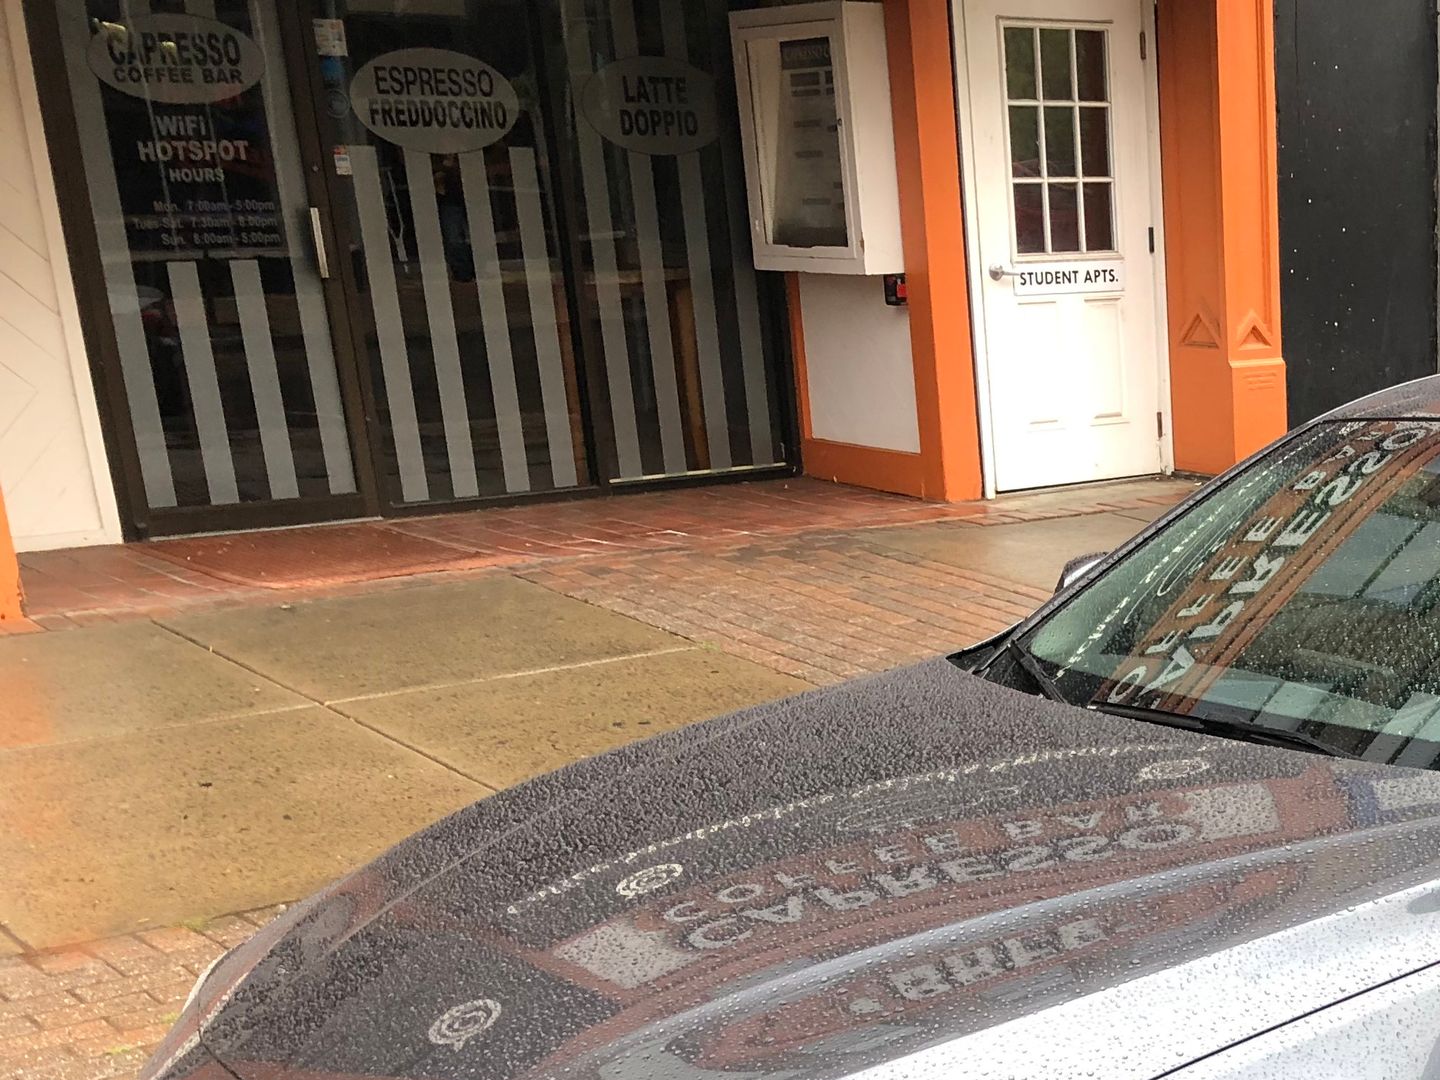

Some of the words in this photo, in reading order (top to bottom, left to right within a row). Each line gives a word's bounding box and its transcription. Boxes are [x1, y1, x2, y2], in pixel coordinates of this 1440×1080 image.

[114, 67, 194, 83] COFFEE
[203, 67, 244, 84] BAR
[374, 65, 494, 98] ESPRESSO
[623, 75, 688, 104] LATTE
[368, 97, 507, 130] FREDDOCCINO
[619, 109, 698, 137] DOPPIO
[137, 139, 249, 161] HOTSPOT
[169, 167, 225, 183] HOURS
[1018, 269, 1079, 287] STUDENT
[1083, 267, 1119, 285] APTS.
